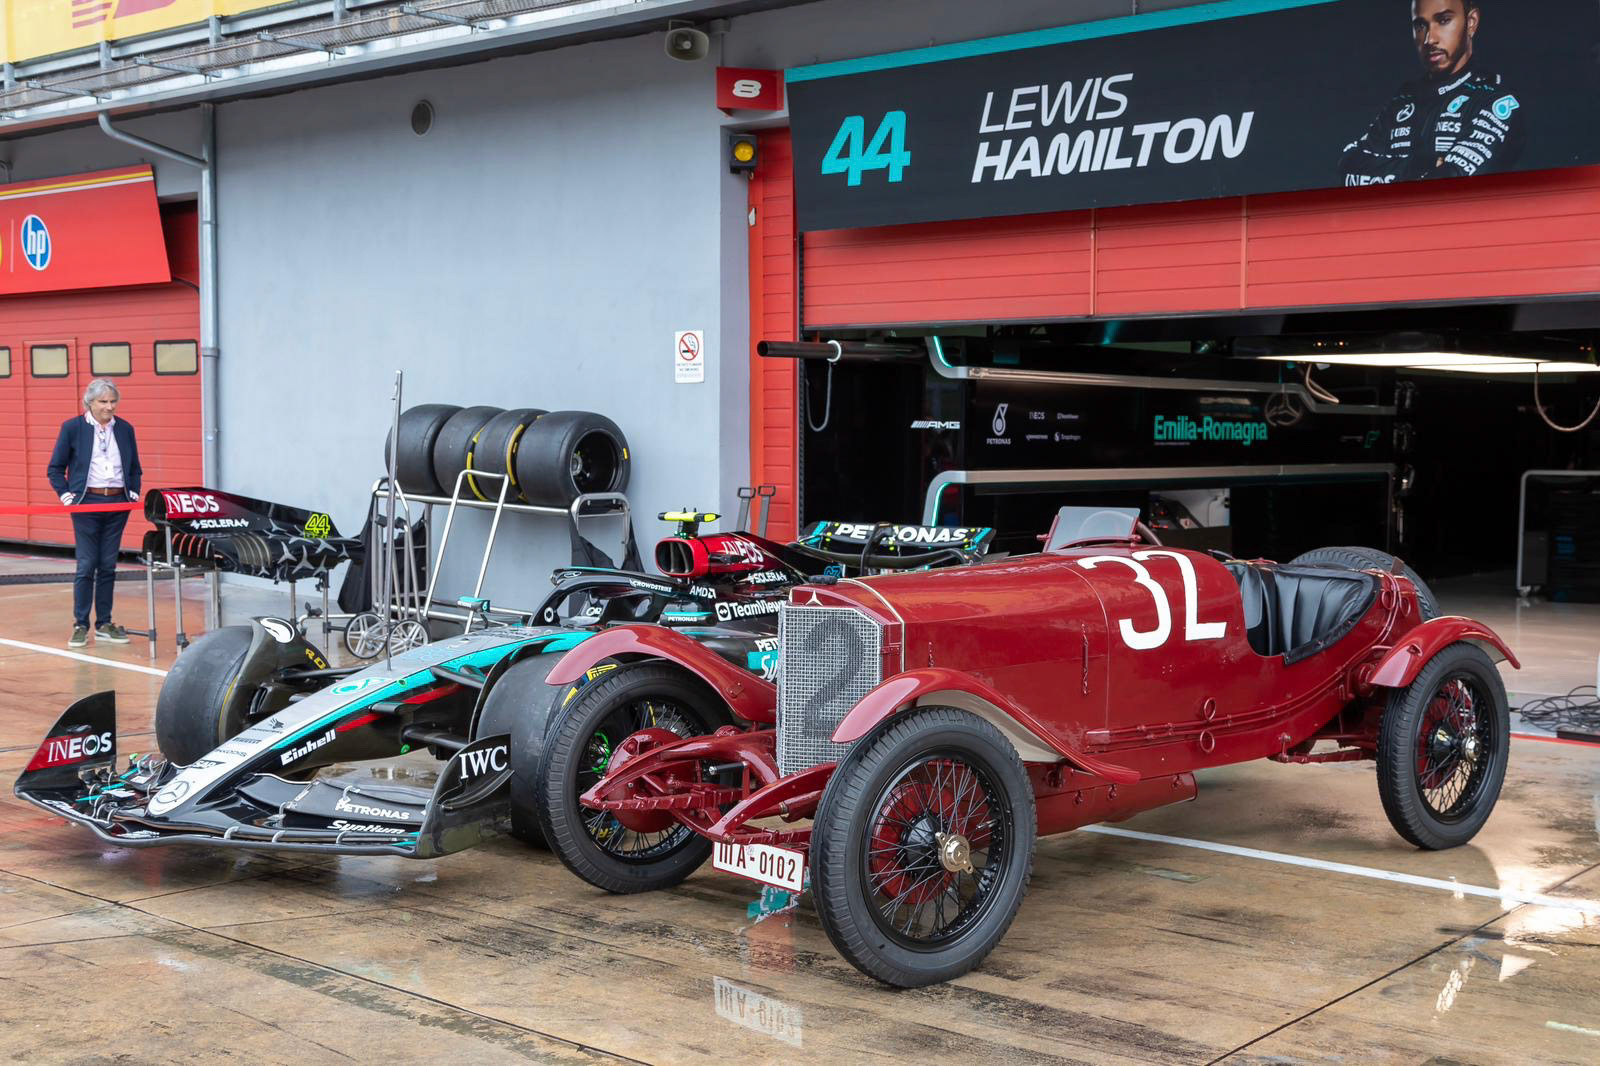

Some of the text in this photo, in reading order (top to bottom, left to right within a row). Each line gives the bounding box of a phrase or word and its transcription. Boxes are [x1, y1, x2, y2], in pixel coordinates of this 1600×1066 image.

[732, 79, 762, 98] 8
[979, 73, 1134, 133] LEWIS
[821, 110, 911, 186] 44
[971, 111, 1255, 183] HAMILTON
[26, 214, 47, 268] hp
[1154, 415, 1268, 446] Emilia-Romagna
[200, 518, 241, 529] SOLERA
[305, 513, 331, 535] 44
[835, 523, 968, 543] PEONAS
[1077, 550, 1228, 650] 32
[803, 618, 864, 739] 2
[48, 732, 112, 762] INEOS
[280, 729, 337, 766] Einhell
[458, 745, 508, 780] IWC
[335, 800, 410, 820] PETRONAS
[327, 820, 406, 834] Syntium
